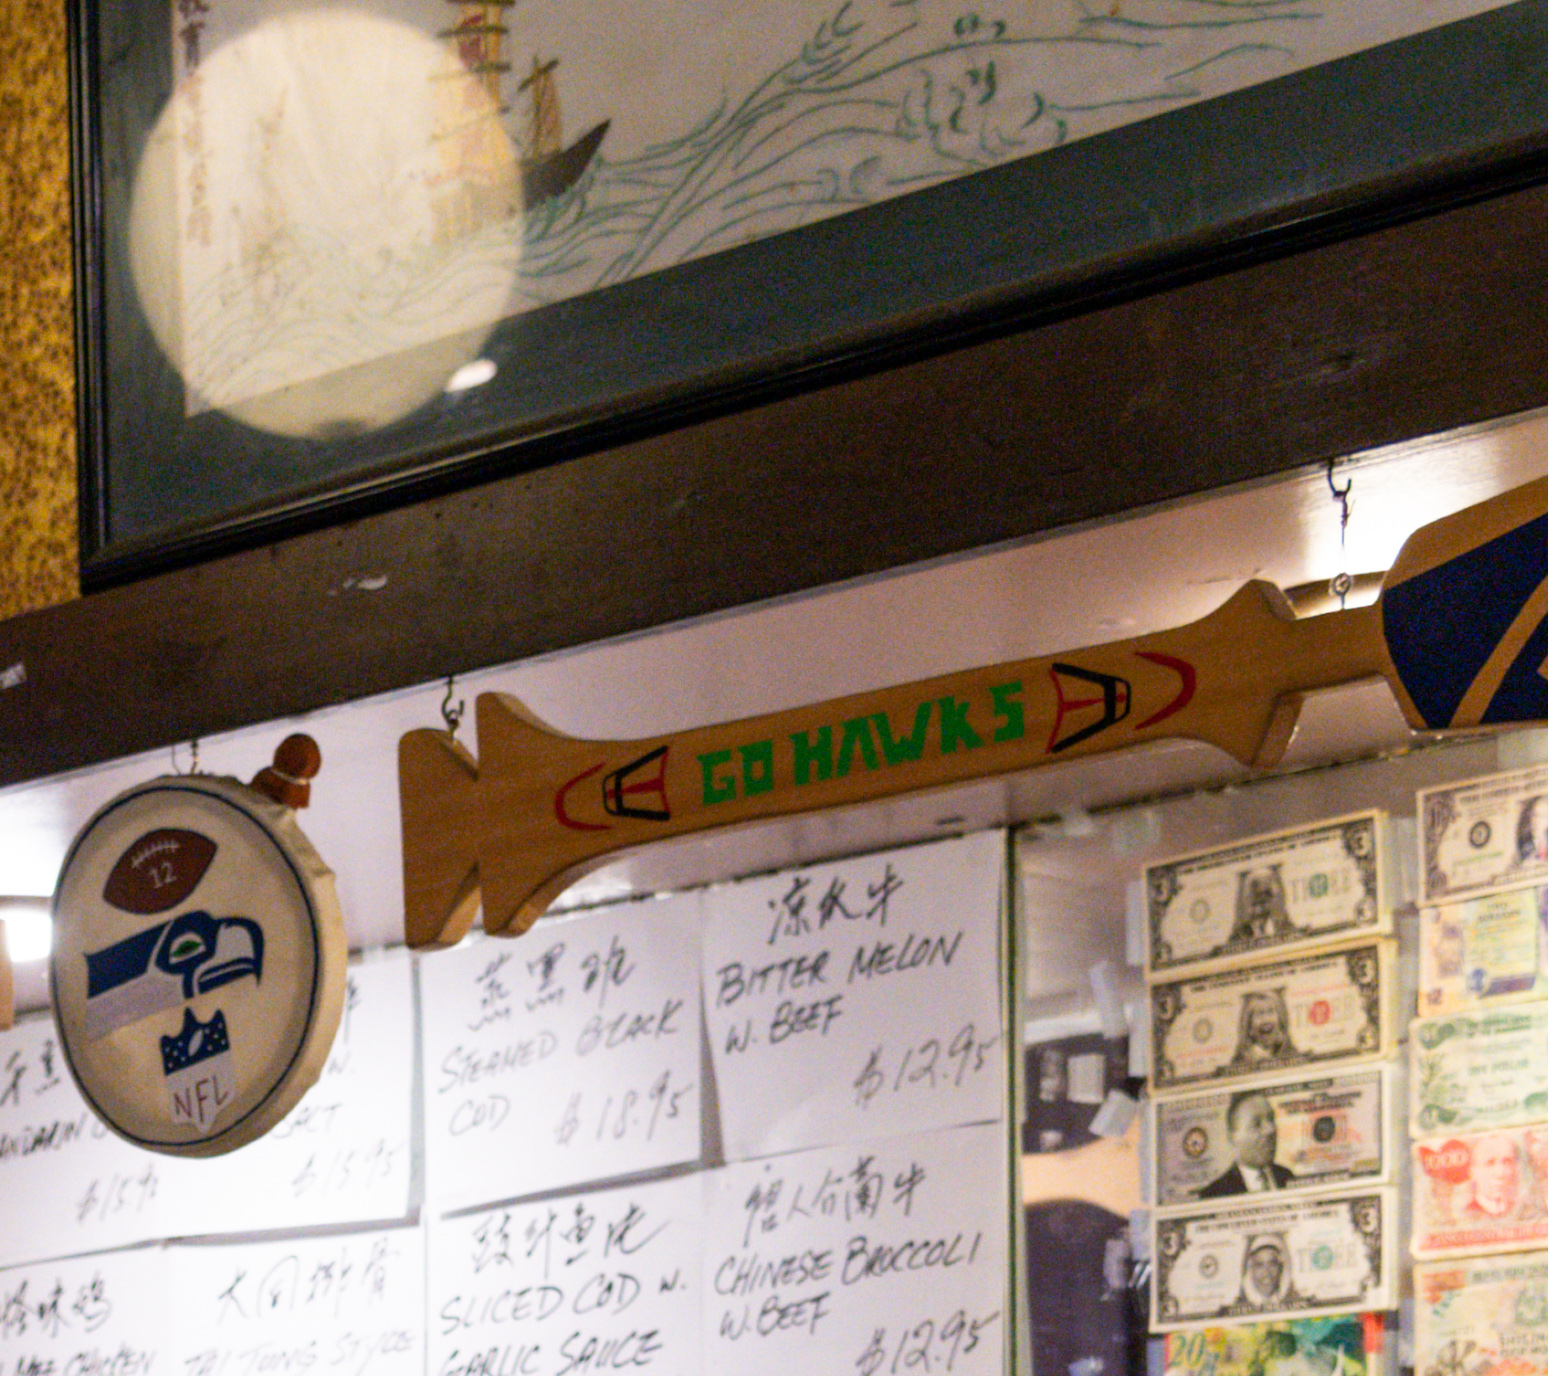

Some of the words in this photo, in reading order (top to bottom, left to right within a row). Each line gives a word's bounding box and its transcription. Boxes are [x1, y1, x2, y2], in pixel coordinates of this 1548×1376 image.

[699, 743, 772, 803] GO
[792, 681, 1026, 784] HAWKS
[147, 857, 178, 892] 12
[714, 947, 833, 1010] BITTER
[846, 930, 967, 987] MELON
[438, 1031, 560, 1095] STEAMED
[577, 998, 685, 1058] BLACK
[768, 993, 845, 1048] BEEF
[172, 1074, 230, 1124] NFL
[852, 1022, 1001, 1110] $12.95
[449, 1094, 512, 1137] COD
[714, 1247, 835, 1298] CHINESE
[840, 1231, 984, 1289] BROCCOLI
[440, 1284, 567, 1337] SLICED
[572, 1271, 642, 1316] COD
